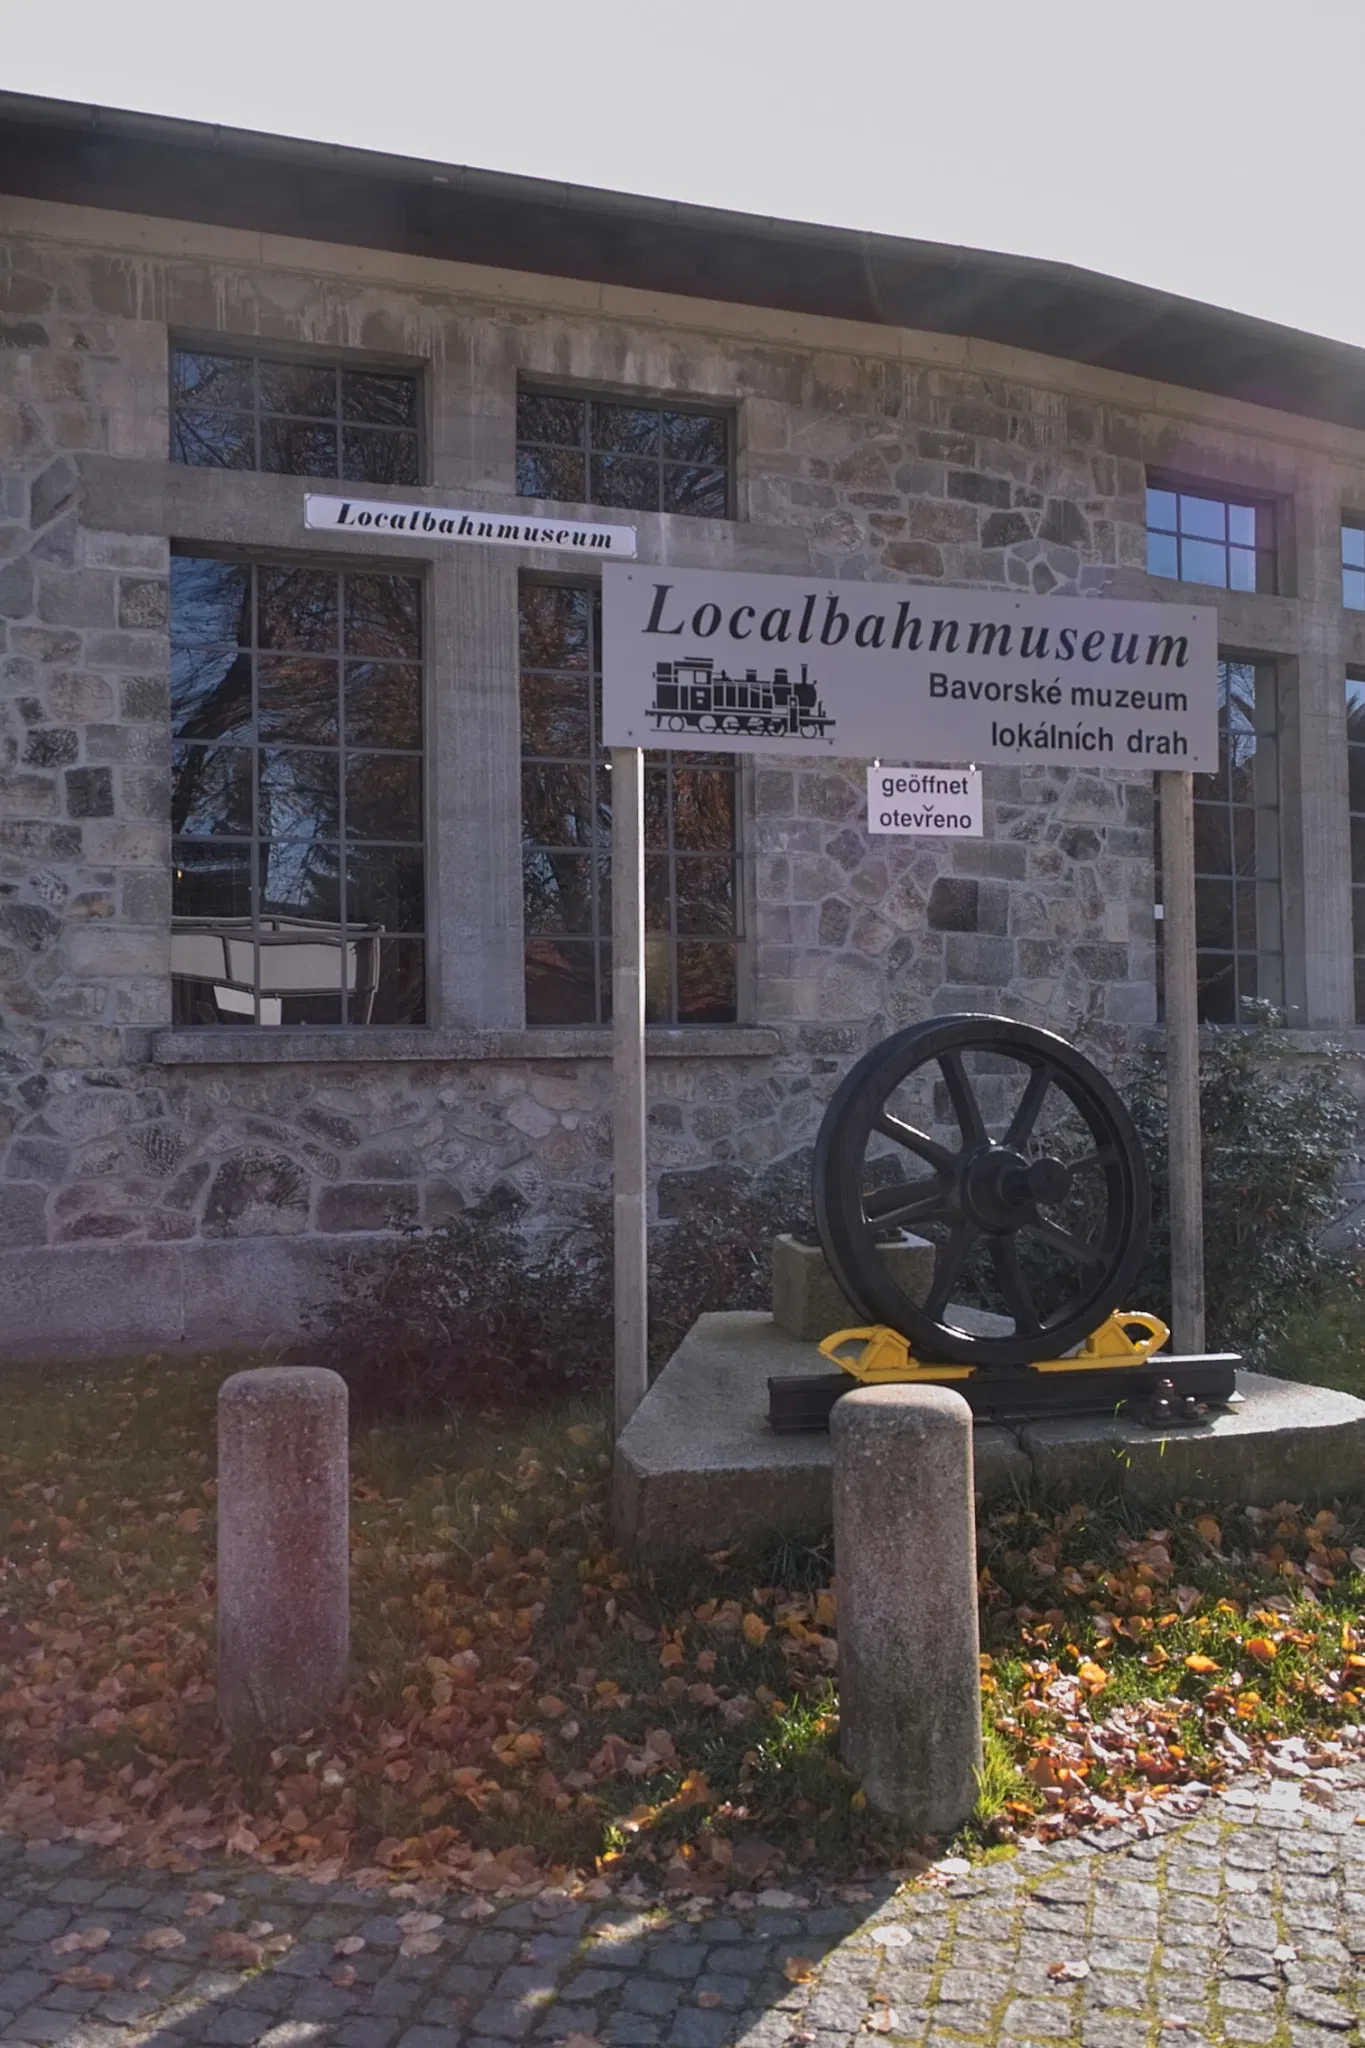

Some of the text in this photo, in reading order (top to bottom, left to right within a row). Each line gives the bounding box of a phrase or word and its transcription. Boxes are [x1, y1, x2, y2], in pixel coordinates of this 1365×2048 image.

[336, 502, 612, 549] Localbahnmuseum
[641, 583, 1190, 668] Localbahnmuseum
[928, 672, 1188, 712] Bavorské muzeum
[991, 721, 1188, 756] lokálních drah
[881, 772, 969, 798] geöffnet
[878, 804, 972, 830] otevřeno
